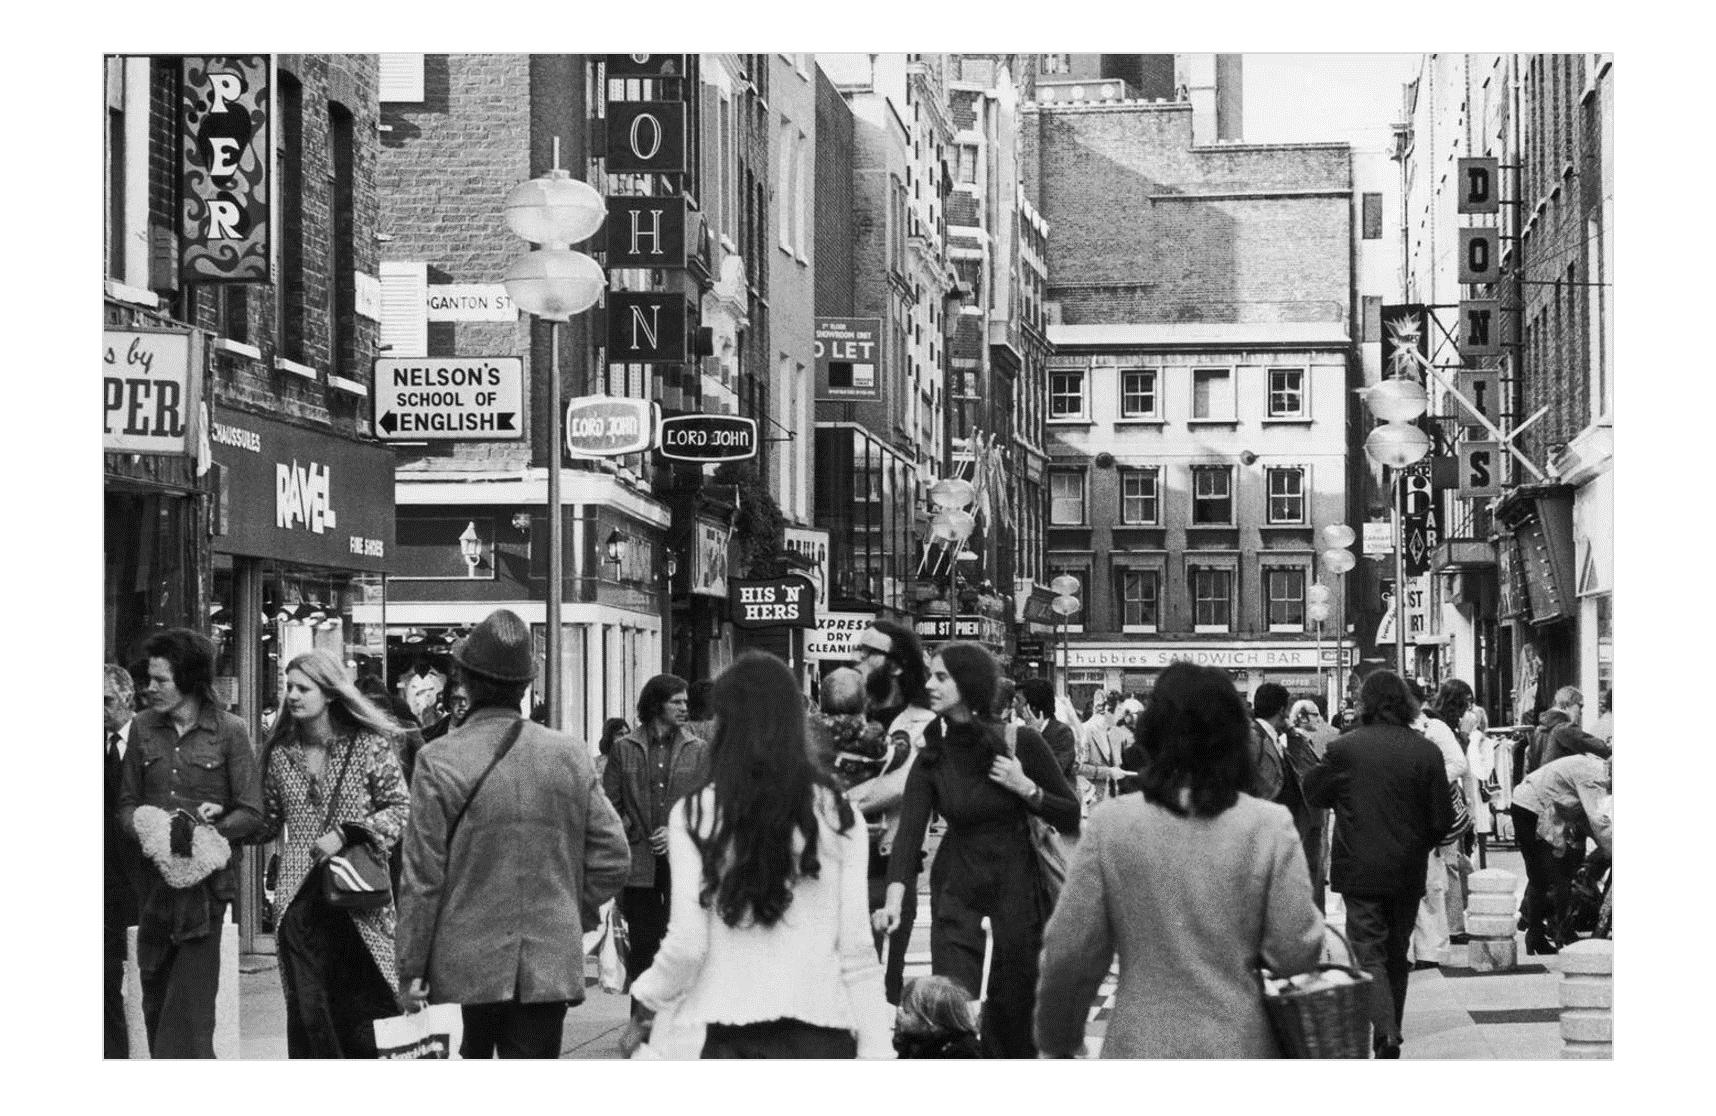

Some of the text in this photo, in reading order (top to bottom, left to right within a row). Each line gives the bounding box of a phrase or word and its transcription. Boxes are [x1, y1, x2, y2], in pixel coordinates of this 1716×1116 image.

[206, 73, 244, 240] PER
[496, 296, 512, 309] ST
[1467, 167, 1491, 488] DONIS
[127, 336, 154, 375] by
[831, 340, 876, 359] LET
[393, 362, 501, 387] NELSON'S
[103, 376, 186, 438] PER
[396, 391, 497, 407] SCHOOL OF
[400, 412, 494, 431] ENGLISH
[572, 414, 639, 438] LORD JOHN
[666, 430, 749, 446] LORD JOHN
[276, 457, 337, 535] RAVEL
[739, 586, 776, 603] HIS
[744, 604, 800, 620] HERS
[817, 618, 872, 631] XPRESS
[938, 621, 980, 636] STPHEN
[826, 632, 852, 642] DRY
[807, 643, 852, 654] CLEANI
[1158, 652, 1259, 665] SANDWICH
[1267, 652, 1301, 664] BAR
